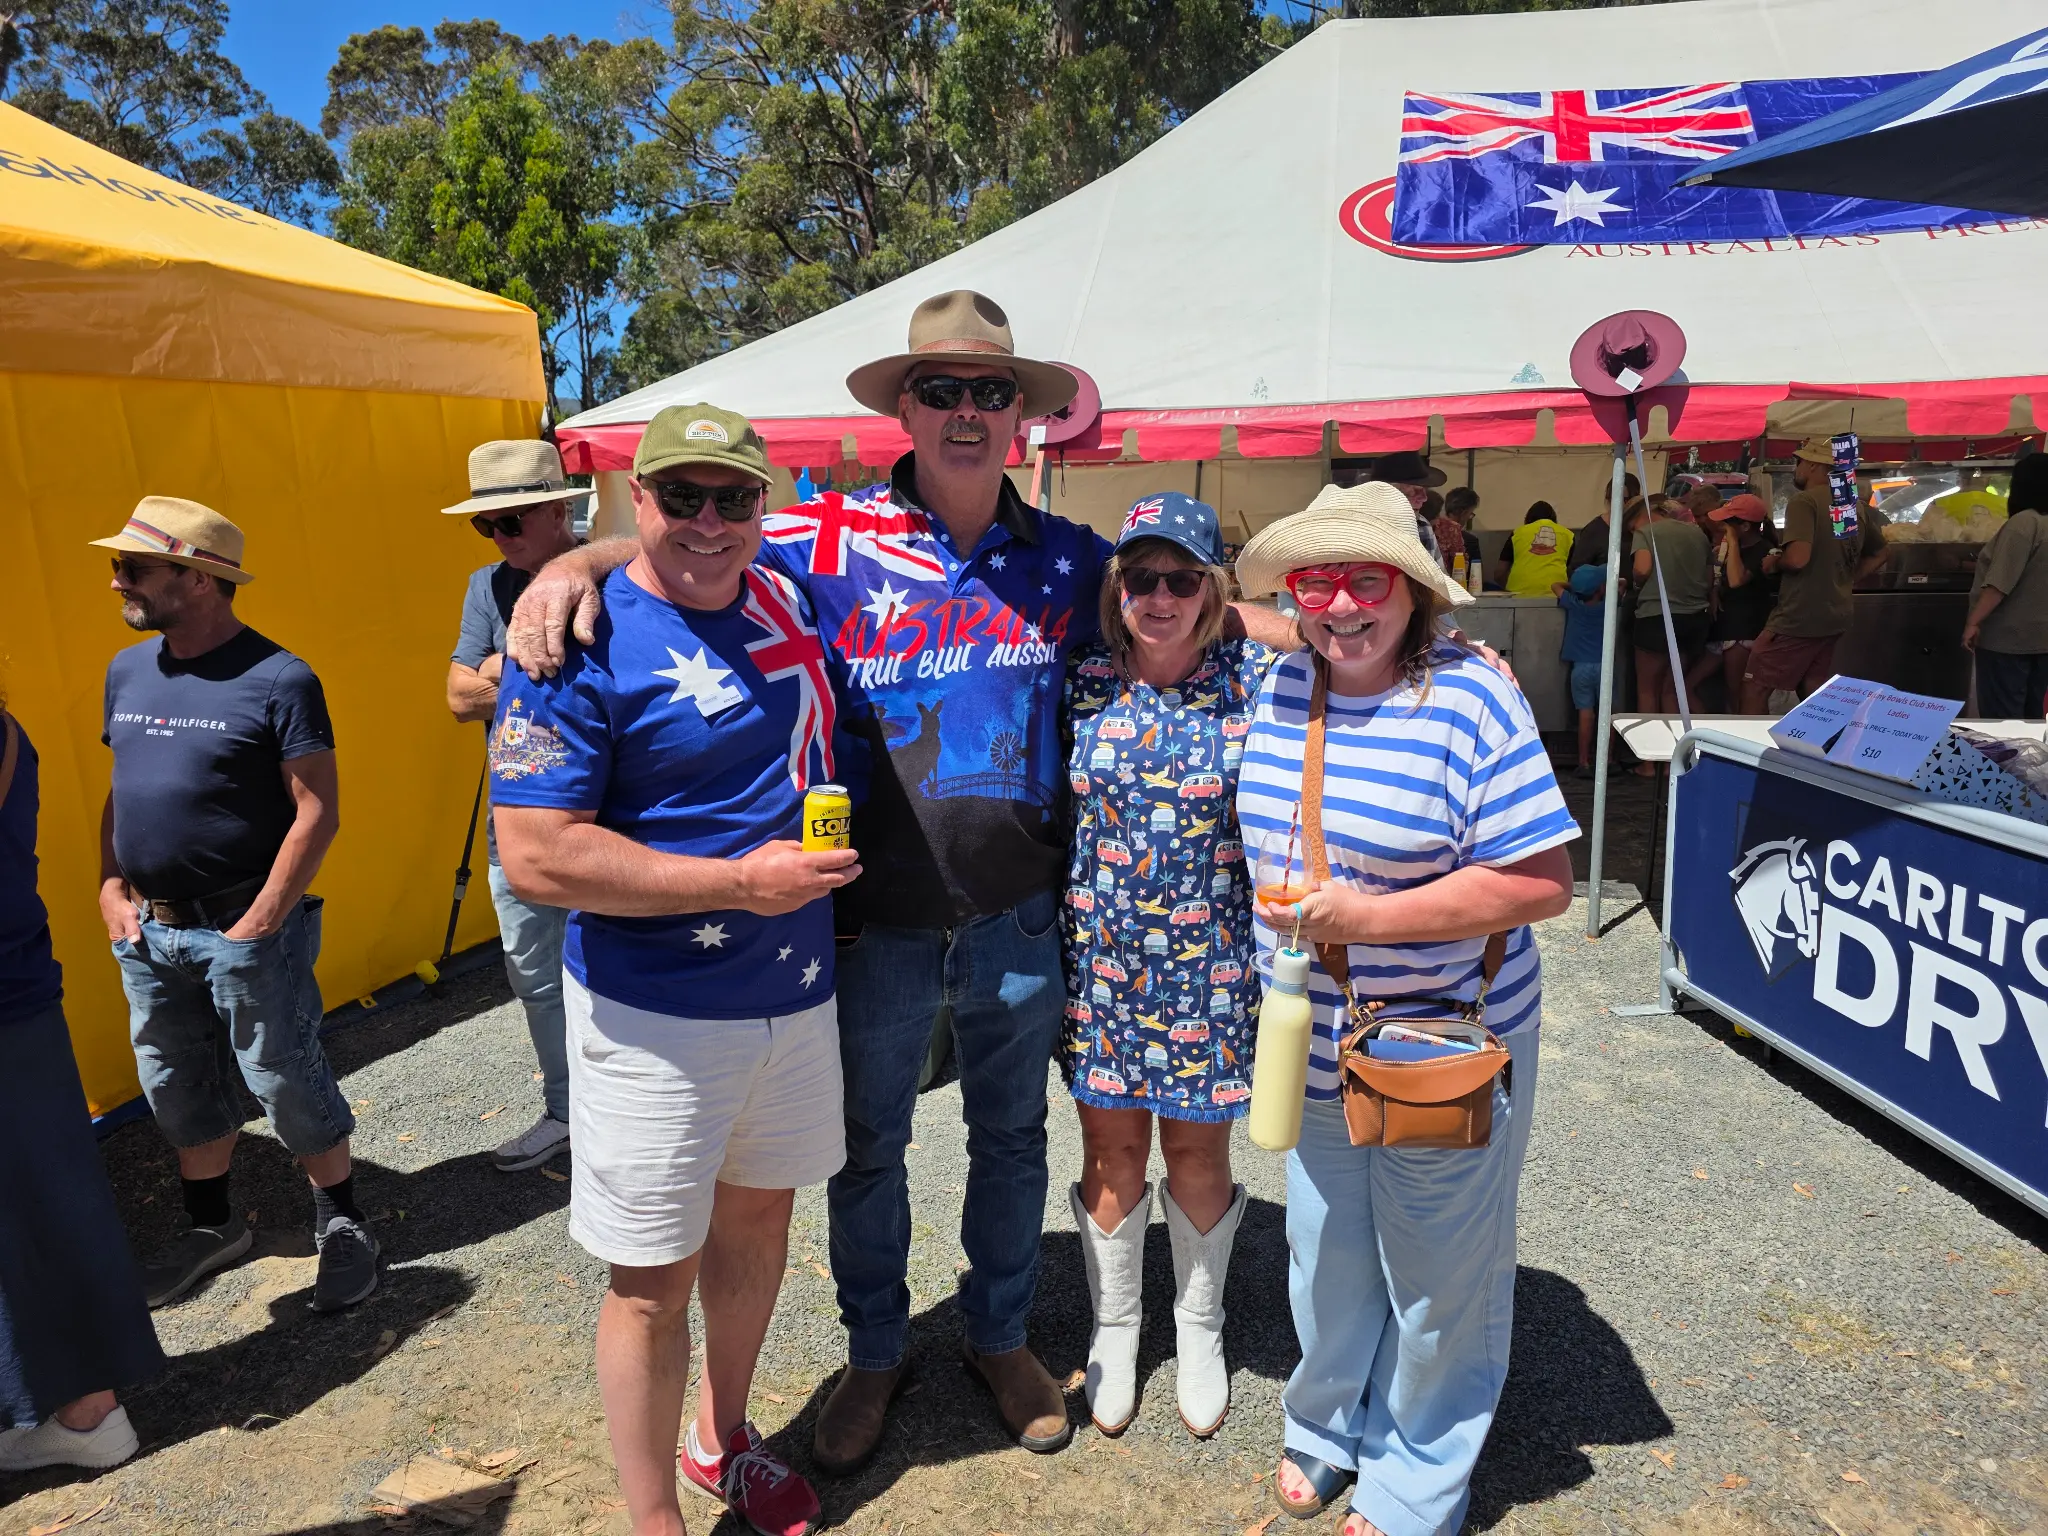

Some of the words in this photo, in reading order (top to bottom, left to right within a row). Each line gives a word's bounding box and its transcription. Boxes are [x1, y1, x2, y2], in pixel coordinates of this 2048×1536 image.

[834, 597, 1074, 664] AUSTRALIA
[846, 653, 908, 690] TRUE
[916, 643, 977, 680] BLUE
[1886, 694, 1908, 704] Bowls
[1909, 699, 1925, 708] Club
[1926, 702, 1946, 711] Shirts
[113, 713, 153, 725] TOMMY
[168, 718, 226, 731] HILFIGER
[1887, 709, 1911, 720] Ladies
[145, 728, 159, 736] EST.
[159, 729, 175, 737] 1985
[1787, 727, 1807, 739] $10
[1848, 720, 1869, 729] SPECIAL
[1869, 724, 1887, 734] PRICE
[1891, 729, 1912, 739] TODAY
[1911, 734, 1930, 742] ONLY
[1861, 746, 1882, 759] $10
[814, 818, 851, 836] SOL
